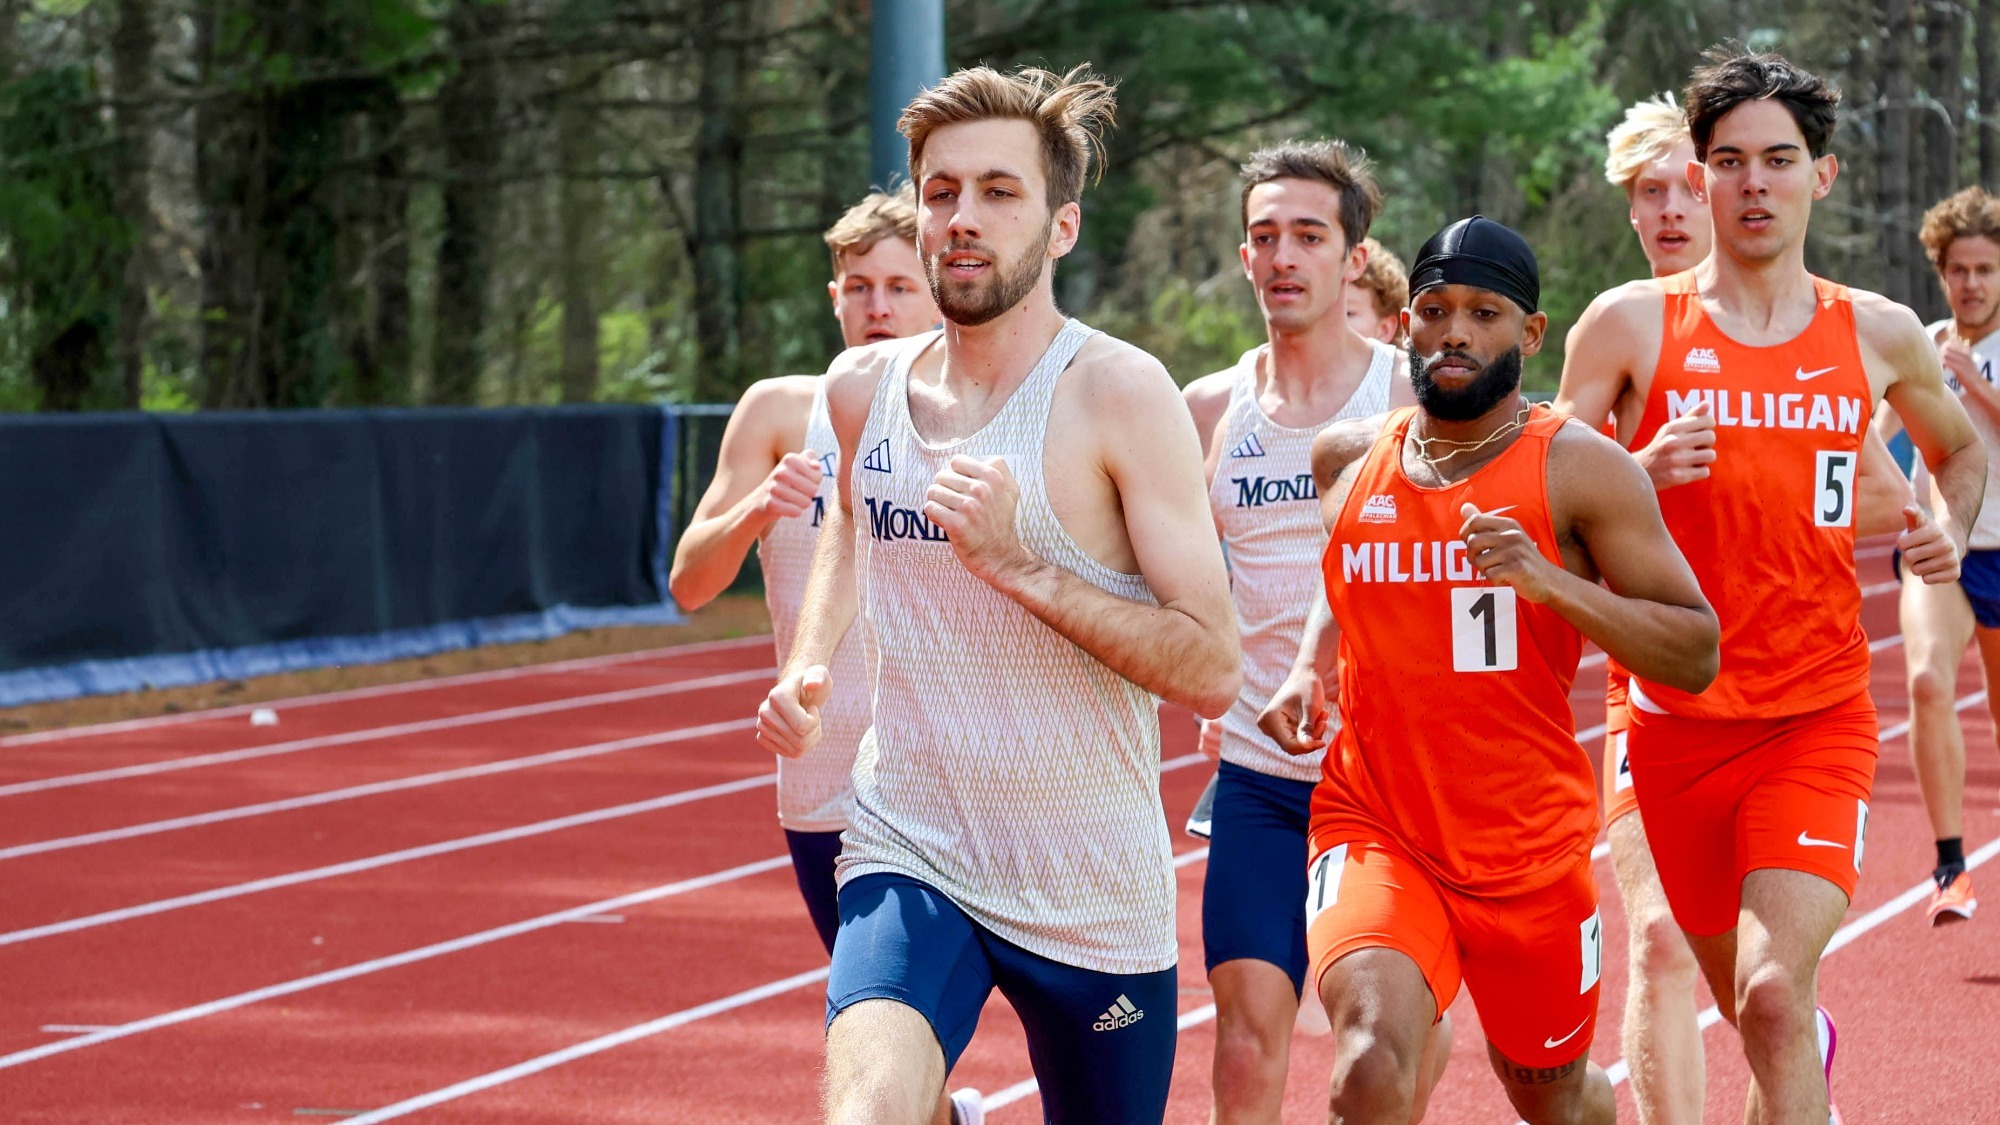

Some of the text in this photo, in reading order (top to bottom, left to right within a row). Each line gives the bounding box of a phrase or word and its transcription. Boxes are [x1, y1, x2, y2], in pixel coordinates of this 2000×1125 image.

[1690, 347, 1715, 359] AAC
[1665, 388, 1861, 435] MILLIGAN
[1367, 494, 1395, 507] AAC
[1823, 456, 1848, 523] 5
[864, 497, 951, 544] MON
[889, 548, 963, 566] COLLE
[1341, 540, 1487, 583] MILLIG
[1468, 592, 1497, 667] 1
[1315, 853, 1331, 912] 1
[1590, 912, 1600, 978] 1
[1092, 1009, 1145, 1032] adidas
